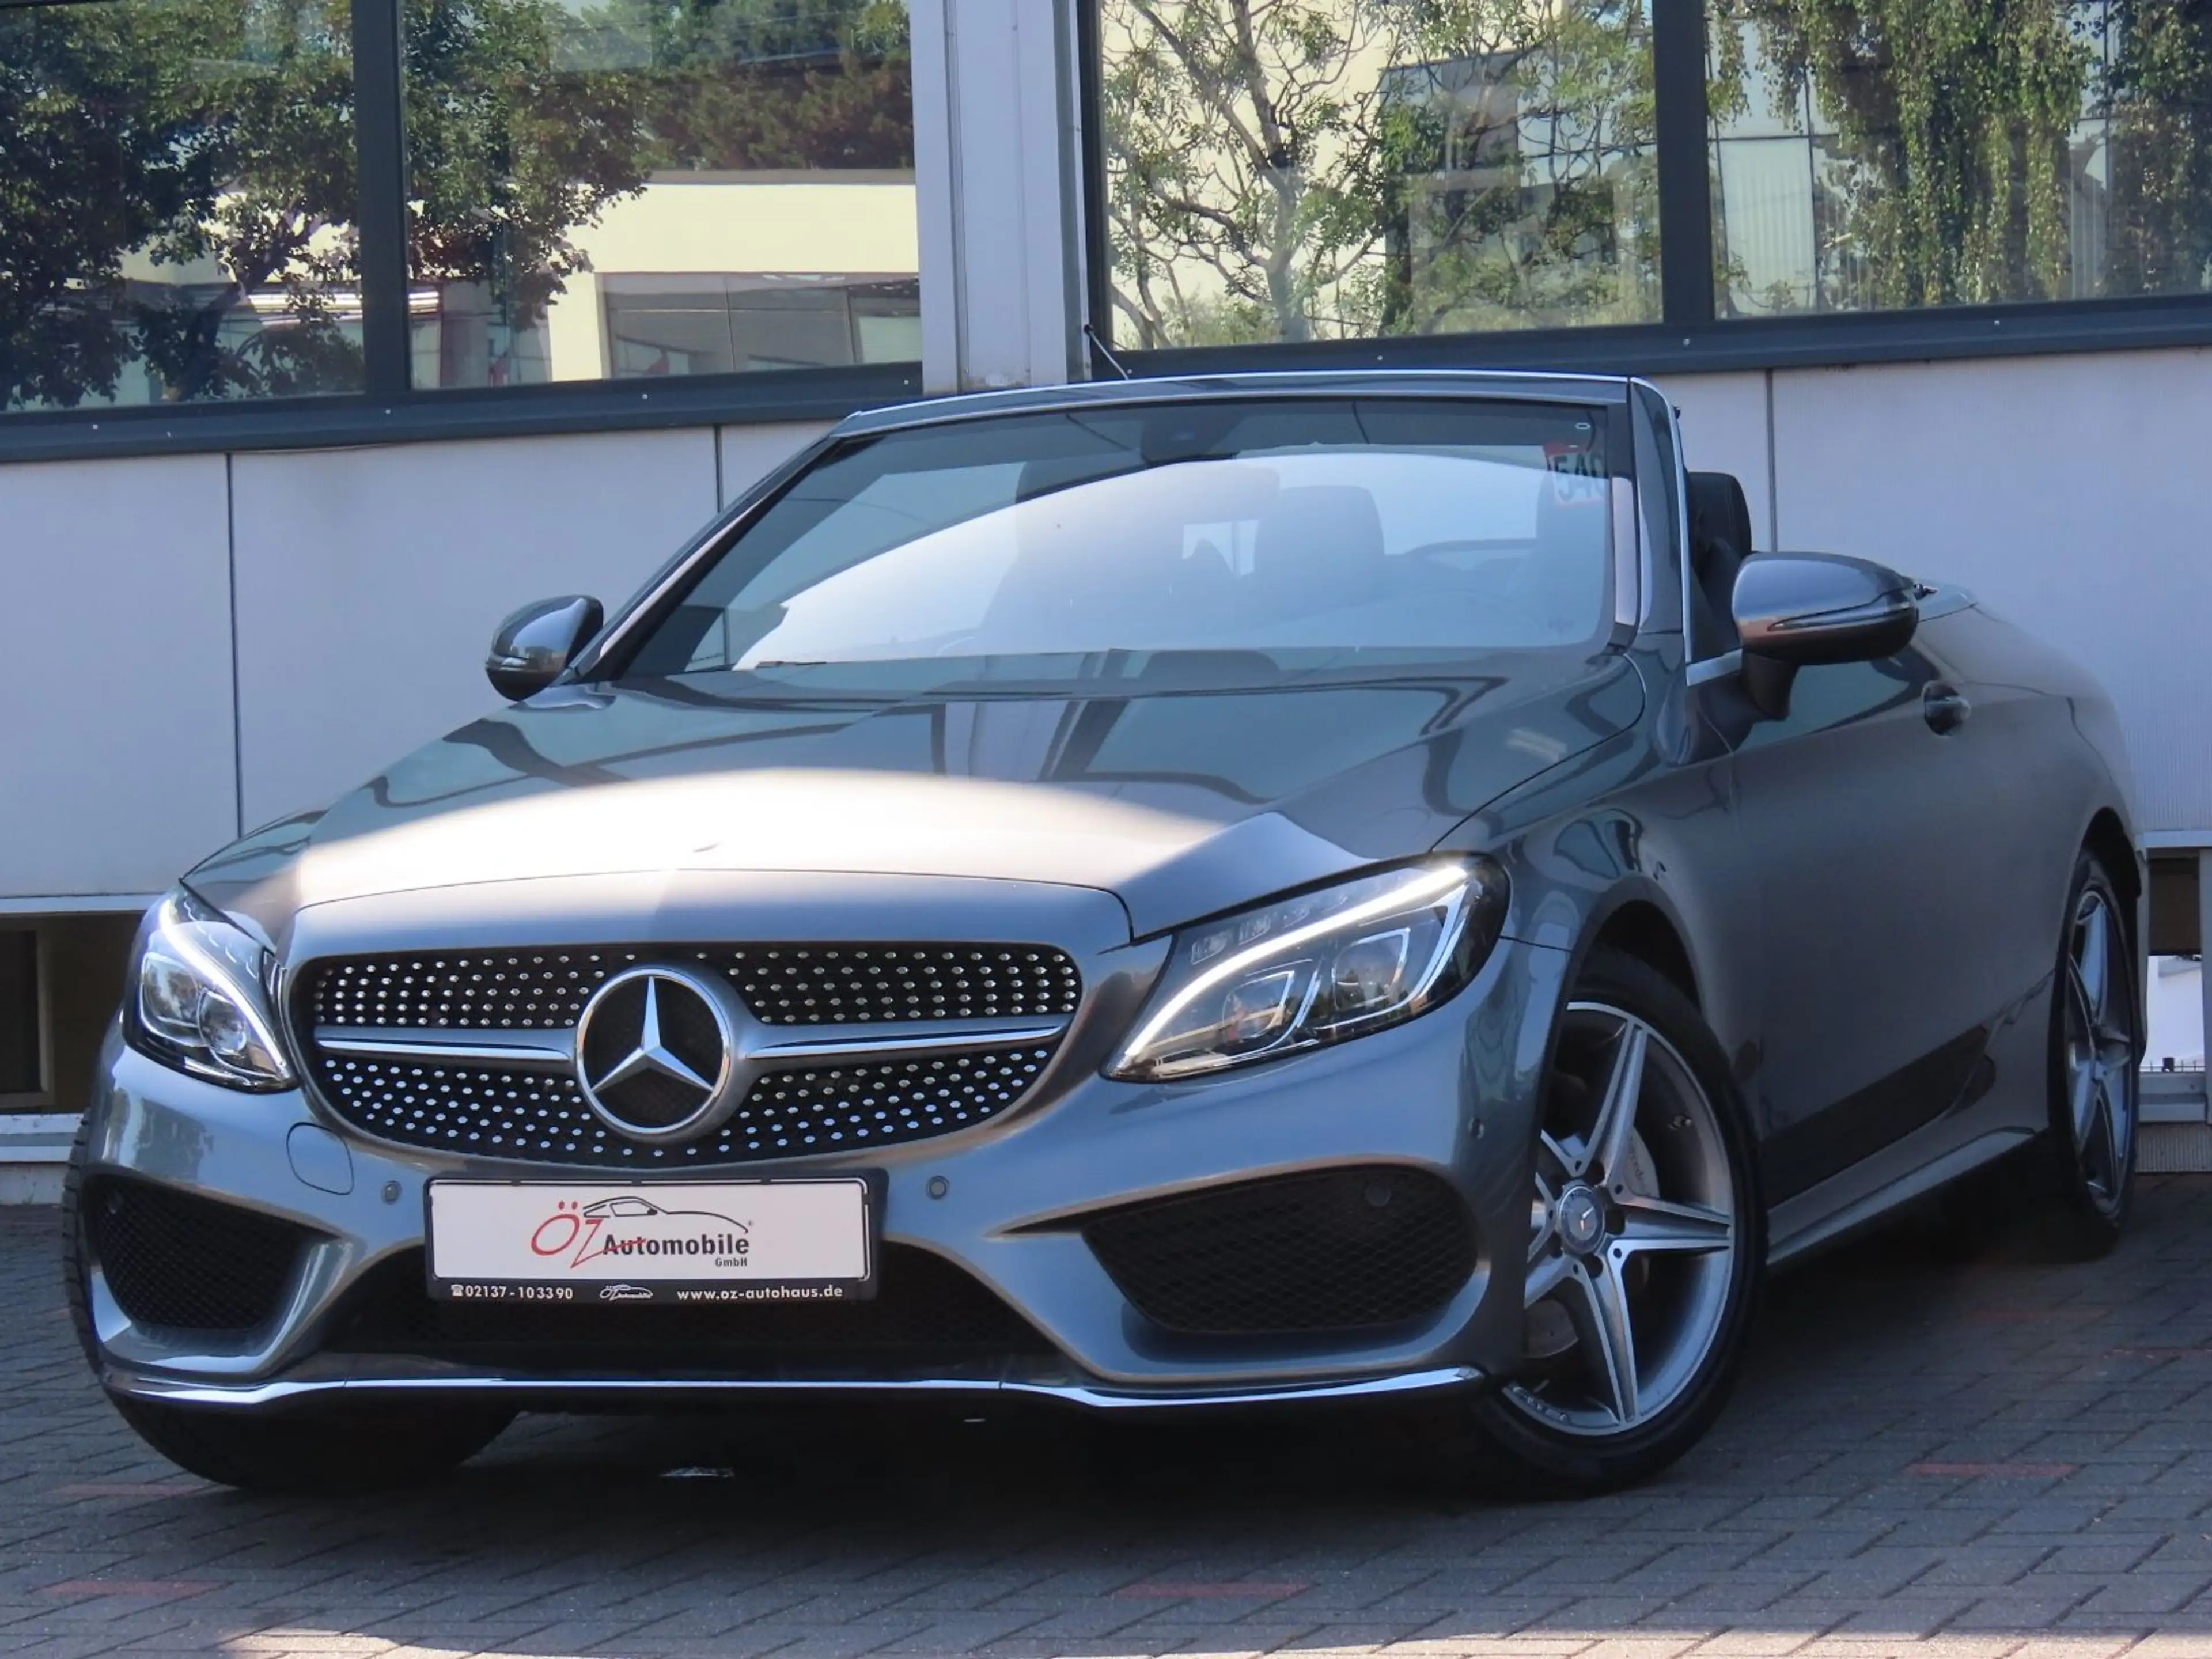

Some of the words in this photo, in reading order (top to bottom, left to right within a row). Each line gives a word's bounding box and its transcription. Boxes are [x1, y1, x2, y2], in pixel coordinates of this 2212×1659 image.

[531, 1200, 611, 1269] ÖZ
[602, 1233, 749, 1256] Automobile
[714, 1257, 748, 1267] GmbH
[676, 1284, 843, 1300] www.oz-autohaus.de
